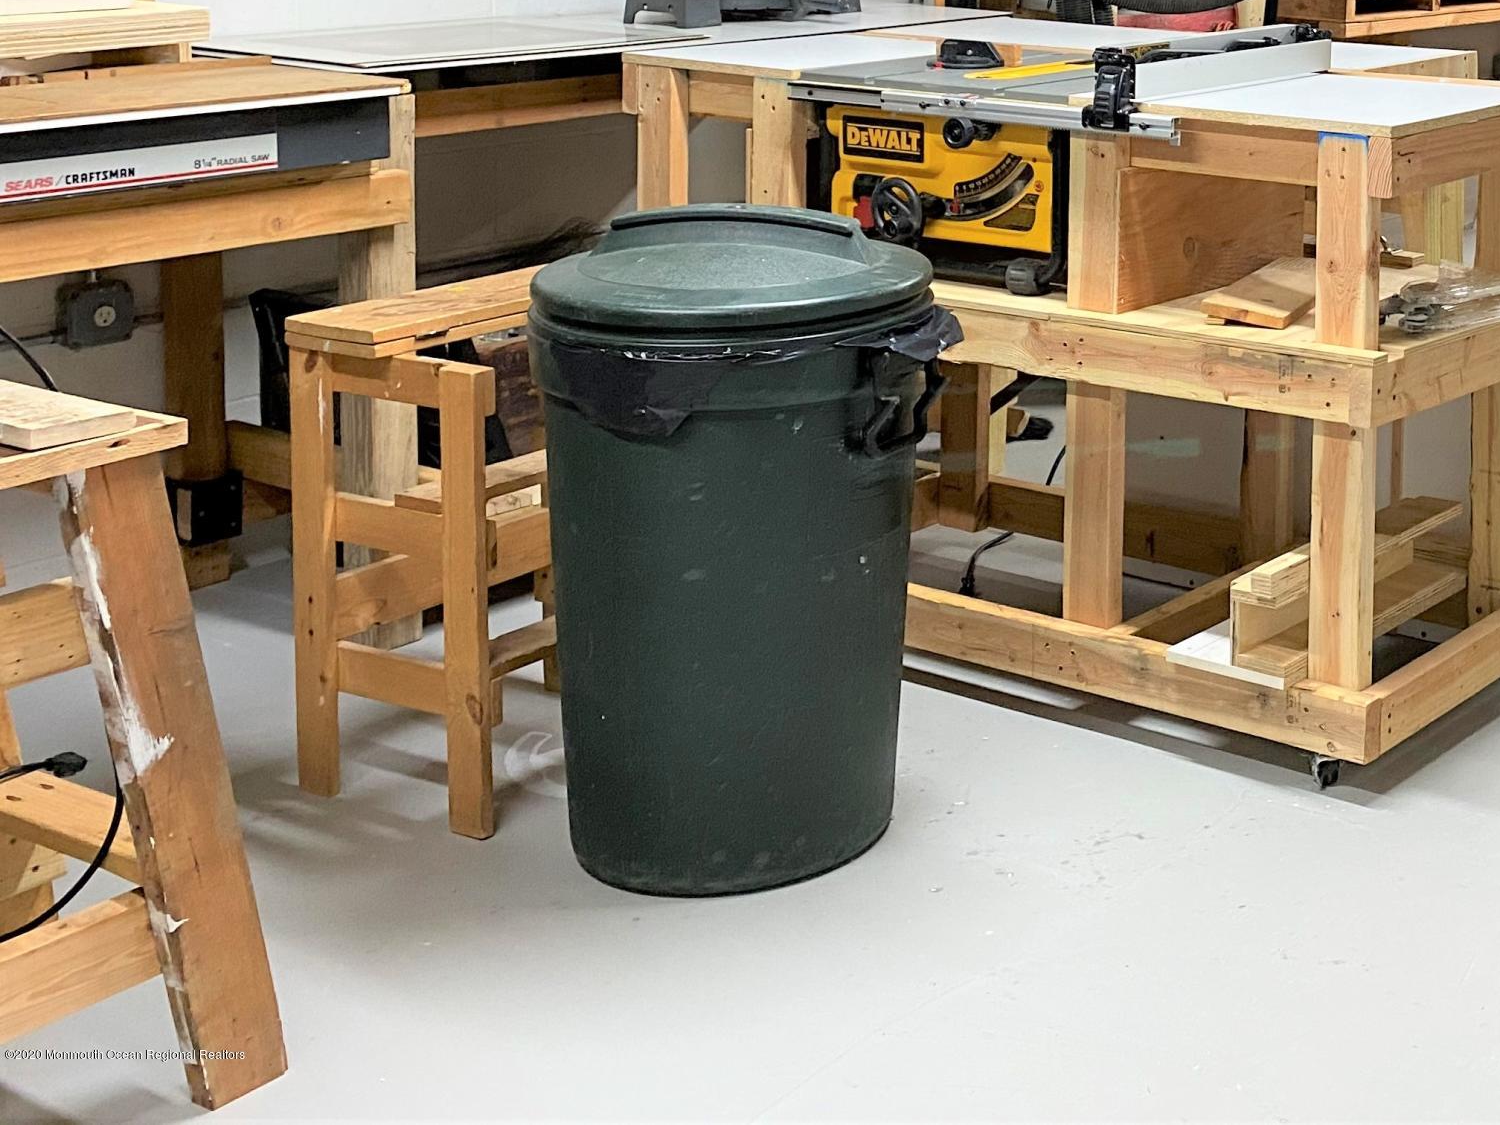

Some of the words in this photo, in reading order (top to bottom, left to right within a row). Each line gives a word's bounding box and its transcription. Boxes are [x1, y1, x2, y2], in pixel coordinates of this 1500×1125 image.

[216, 155, 249, 168] RADIAL
[251, 153, 271, 164] SAW
[4, 176, 53, 193] SEARS
[65, 167, 136, 186] CRAFTSMAN
